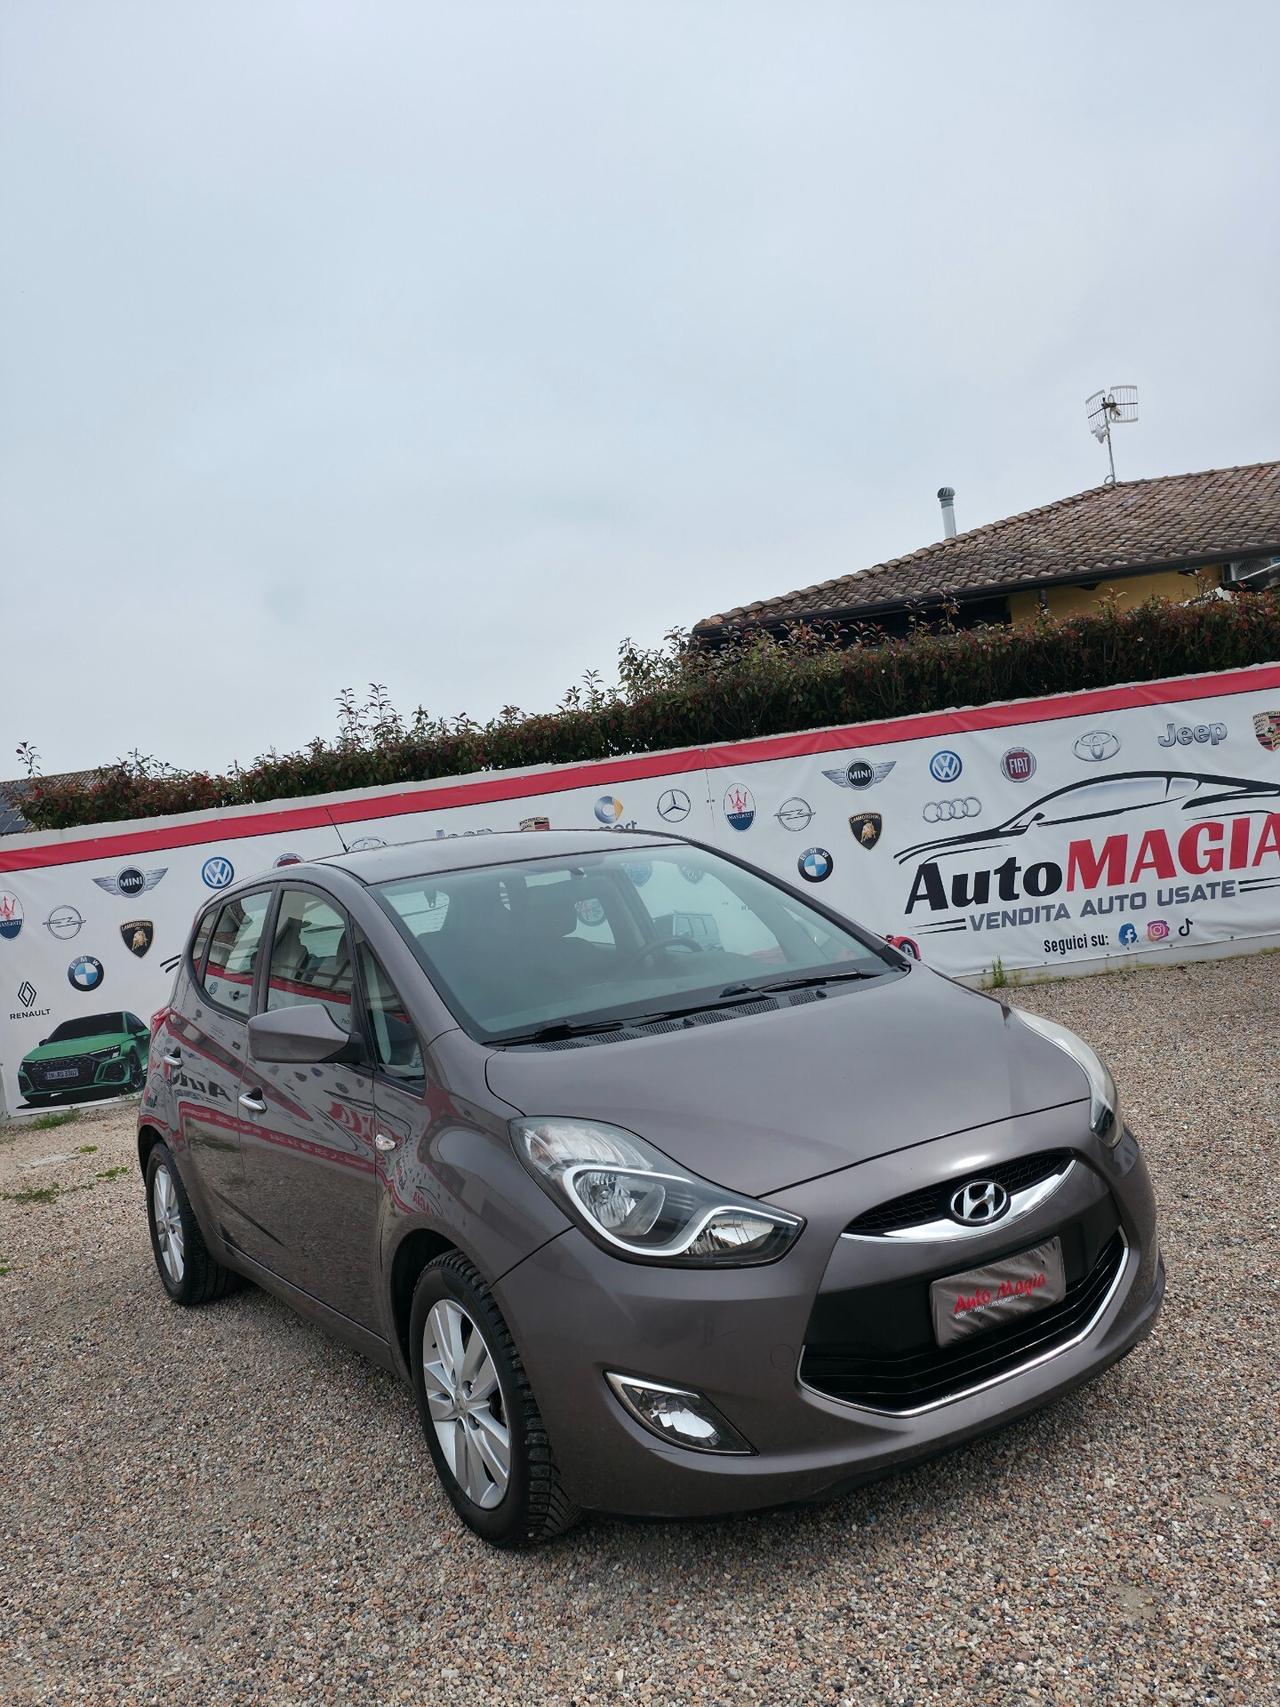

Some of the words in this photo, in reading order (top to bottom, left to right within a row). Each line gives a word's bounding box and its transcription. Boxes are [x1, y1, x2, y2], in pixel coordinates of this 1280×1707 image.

[1158, 722, 1228, 748] Jeep
[848, 769, 872, 781] MINI
[1008, 756, 1029, 774] FIAT
[119, 876, 143, 888] MINI
[969, 902, 1071, 931] VENDITA
[1079, 891, 1147, 917] AUTO
[1157, 879, 1236, 907] USATE
[1043, 933, 1088, 955] Seguici
[1091, 933, 1109, 947] su:
[9, 1008, 51, 1020] RENAULT
[953, 1286, 991, 1314] Auto
[997, 1272, 1047, 1297] Magia
